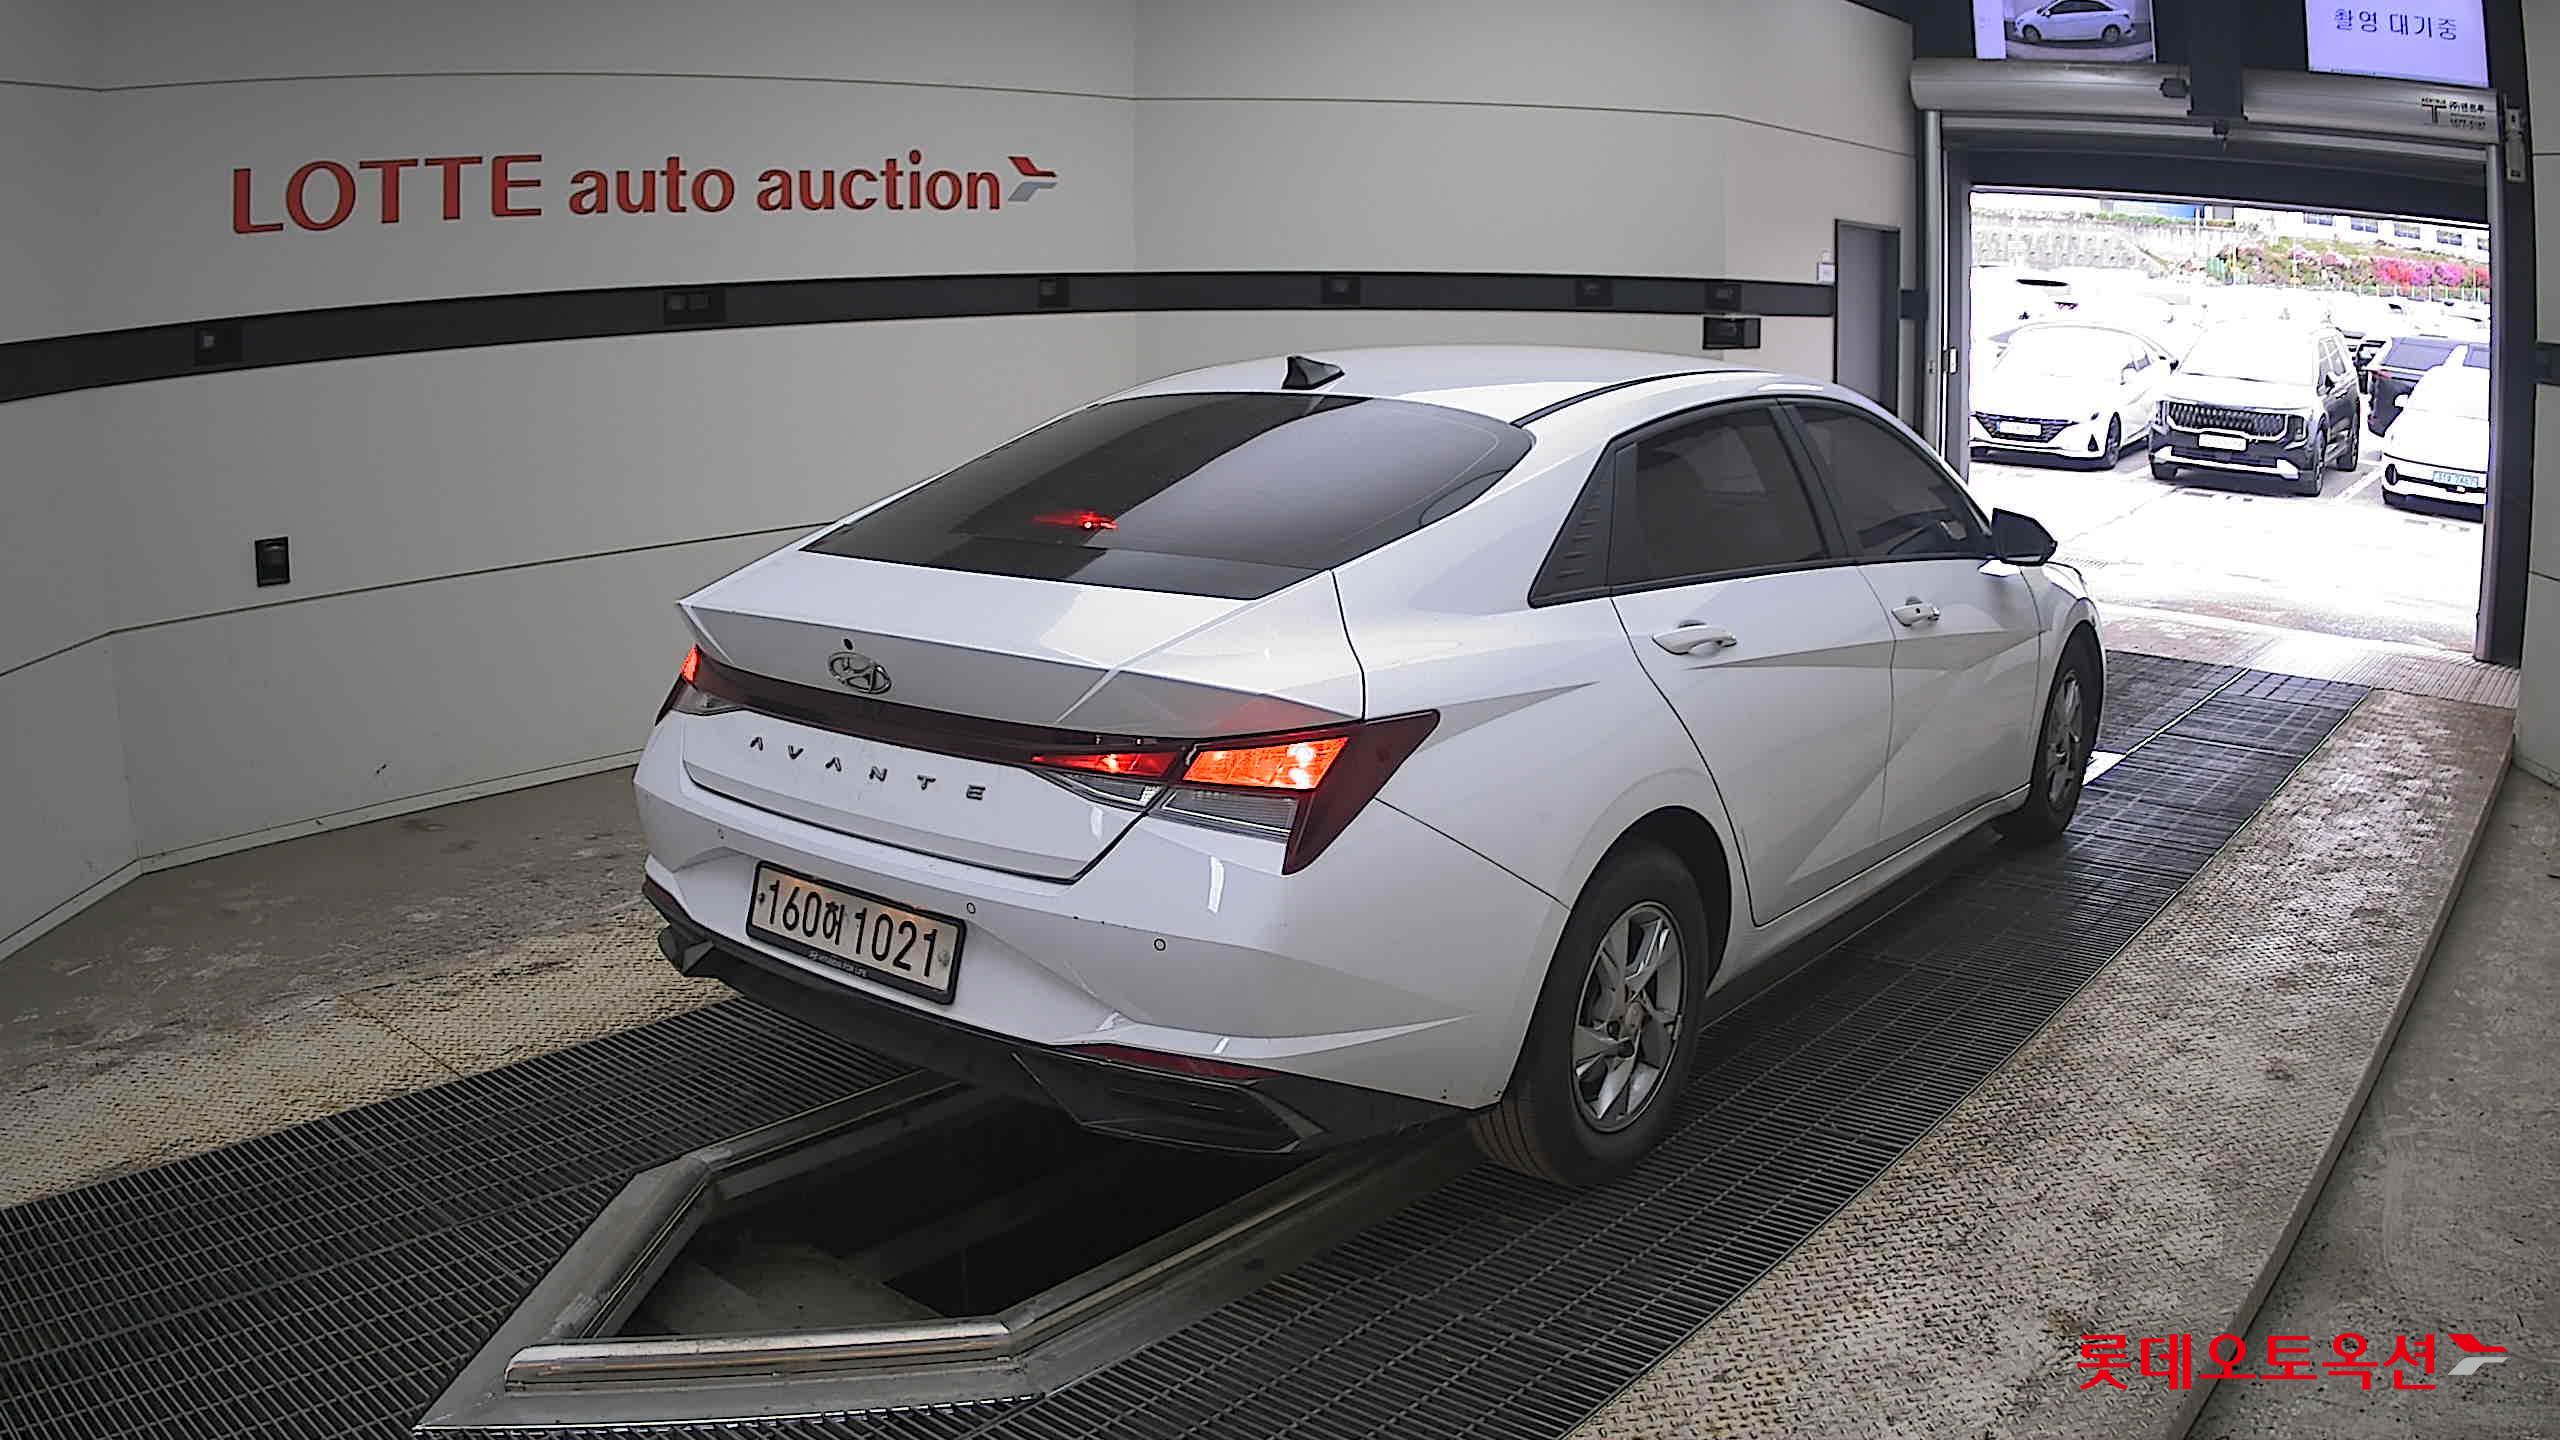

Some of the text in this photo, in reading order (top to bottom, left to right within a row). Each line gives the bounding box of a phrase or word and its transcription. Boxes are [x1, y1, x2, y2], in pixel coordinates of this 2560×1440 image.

[2334, 8, 2457, 41] 촬영 대기중
[233, 150, 1001, 234] LOTTE auto auction
[749, 736, 986, 801] AVANTE
[767, 879, 846, 946] 160허
[854, 907, 939, 978] 1021
